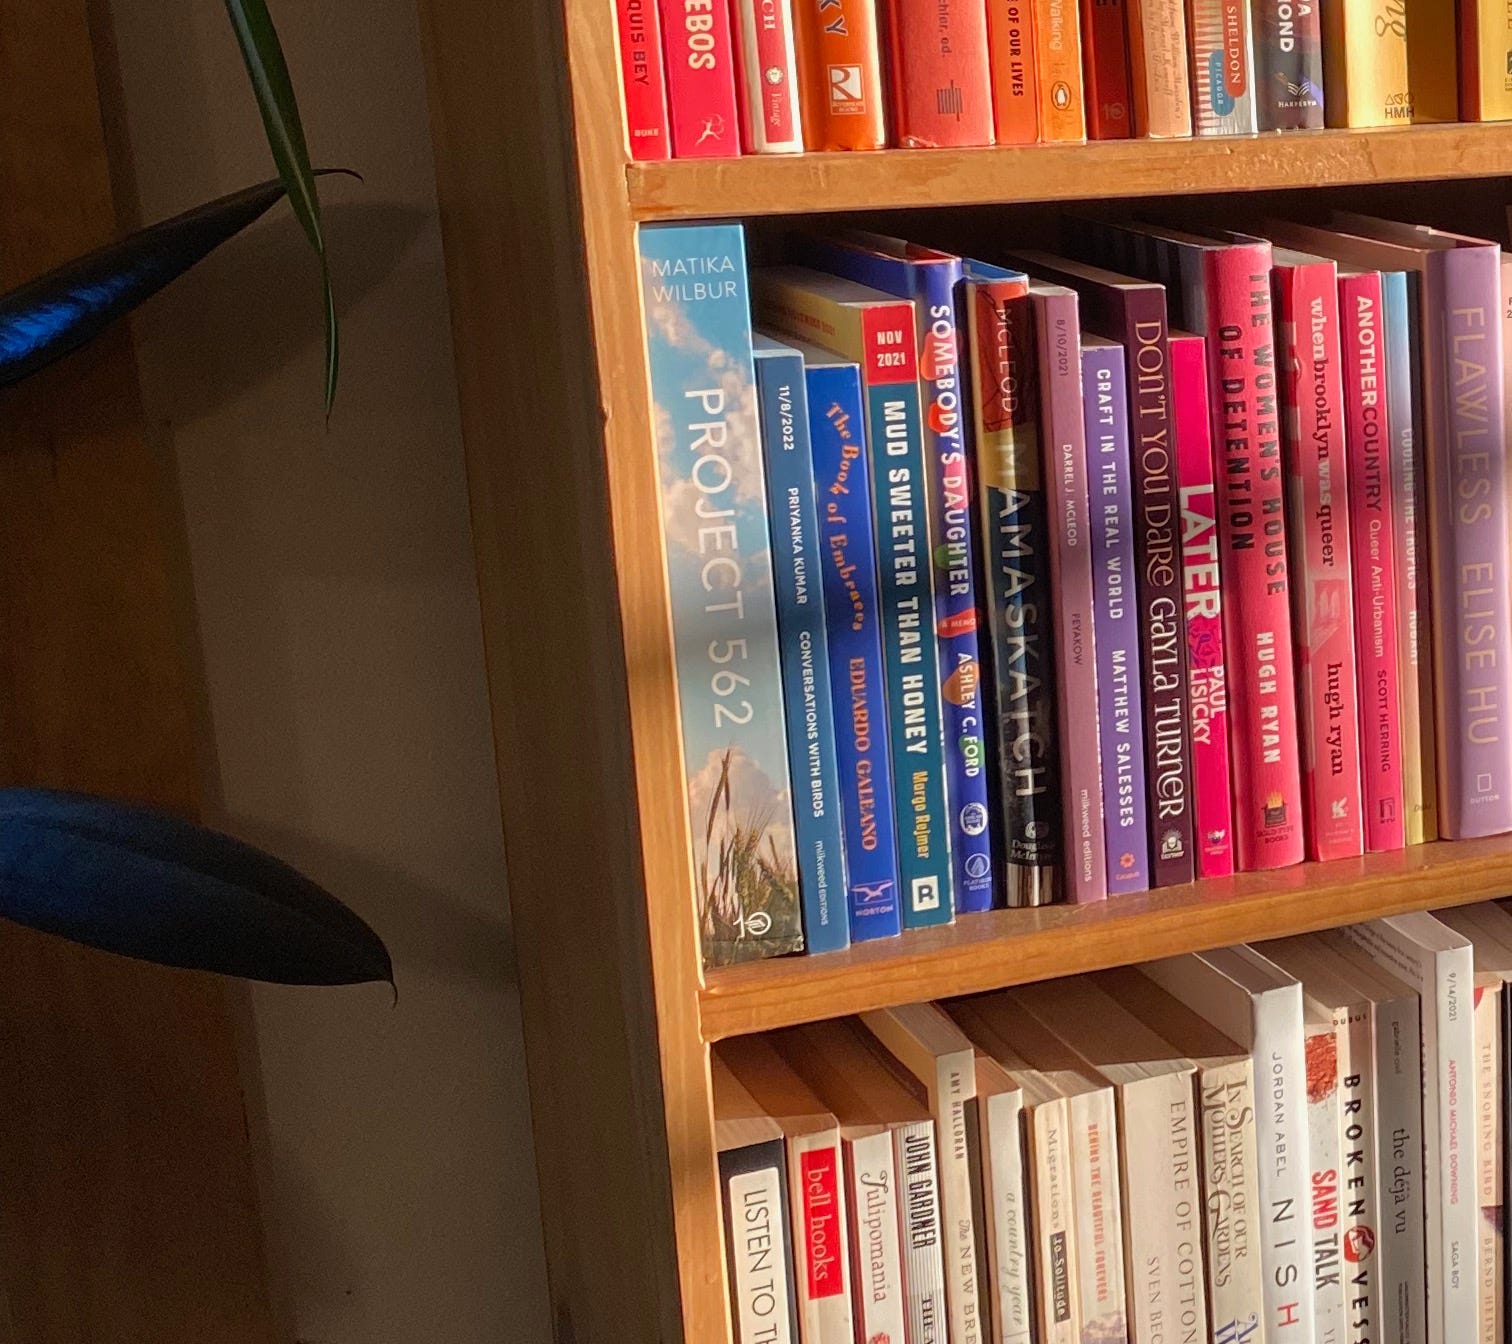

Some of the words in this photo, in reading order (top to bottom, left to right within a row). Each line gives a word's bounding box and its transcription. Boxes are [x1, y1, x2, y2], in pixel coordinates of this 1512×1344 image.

[652, 260, 736, 274] MATIKA
[653, 284, 738, 299] WILBUR
[876, 331, 903, 346] NOV
[877, 352, 906, 367] 2021
[1219, 325, 1242, 362] OF
[929, 305, 963, 466] SOMEBODY'S
[1097, 369, 1116, 426] CRAFT
[1452, 307, 1492, 526] FLAWLESS
[777, 385, 794, 451] 11/8/2022
[883, 401, 908, 458] MUD
[1101, 435, 1117, 451] IN
[1102, 460, 1119, 496] THE
[1221, 378, 1253, 551] DETENTION
[684, 388, 746, 619] PROJECT
[787, 487, 804, 553] PRIYANKA
[887, 470, 916, 585] SWEETER
[943, 476, 971, 595] DAUGHTER
[1104, 505, 1122, 550] REAL
[791, 556, 806, 604] KUMAR
[1179, 484, 1220, 619] LATER
[1107, 556, 1125, 620] WORLD
[1460, 563, 1495, 671] ELISE
[896, 597, 922, 664] THAN
[710, 640, 754, 729] 562
[798, 631, 818, 740] CONVERSATIONS
[1111, 650, 1131, 735] MATTHEW
[1206, 665, 1226, 720] PAUL
[1257, 632, 1277, 696] HUGH
[900, 675, 928, 754] HONEY
[1189, 667, 1211, 745] LISICKY
[1260, 707, 1281, 763] RYAN
[1467, 686, 1499, 746] HU
[808, 743, 822, 776] WITH
[1117, 743, 1135, 827] SALESSES
[810, 779, 824, 817] BIRDS
[905, 1134, 934, 1175] JOHN
[1169, 1100, 1191, 1190] EMPIRE
[807, 1165, 830, 1206] bell
[908, 1181, 937, 1250] GARDNER
[1175, 1204, 1194, 1230] OF
[1311, 1169, 1338, 1229] SAND
[743, 1189, 772, 1273] LISTEN
[810, 1212, 834, 1281] hooks
[860, 1171, 892, 1303] Tulipomania
[1313, 1233, 1339, 1290] TALK
[751, 1279, 774, 1317] TO
[1177, 1242, 1198, 1344] COTTON
